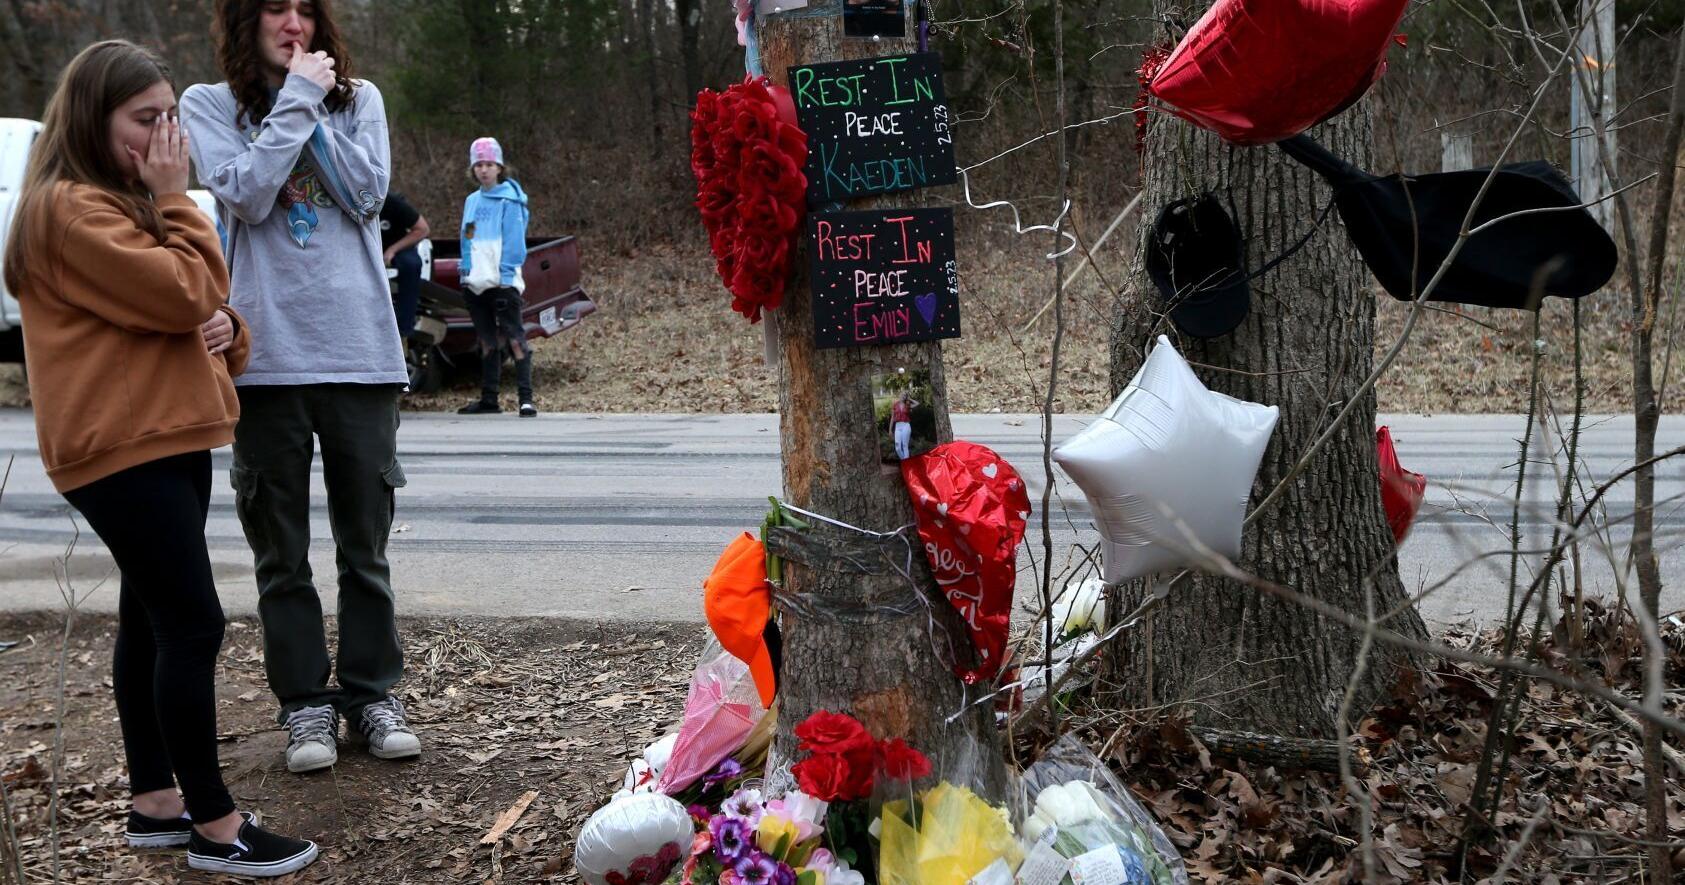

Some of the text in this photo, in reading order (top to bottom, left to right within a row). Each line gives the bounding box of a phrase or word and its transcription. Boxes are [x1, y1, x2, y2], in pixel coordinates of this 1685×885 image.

[845, 111, 904, 137] PEACE
[933, 104, 952, 145] 2.5.23
[820, 141, 927, 198] KAEDEN
[854, 269, 909, 298] PEACE
[853, 301, 910, 341] EMILY
